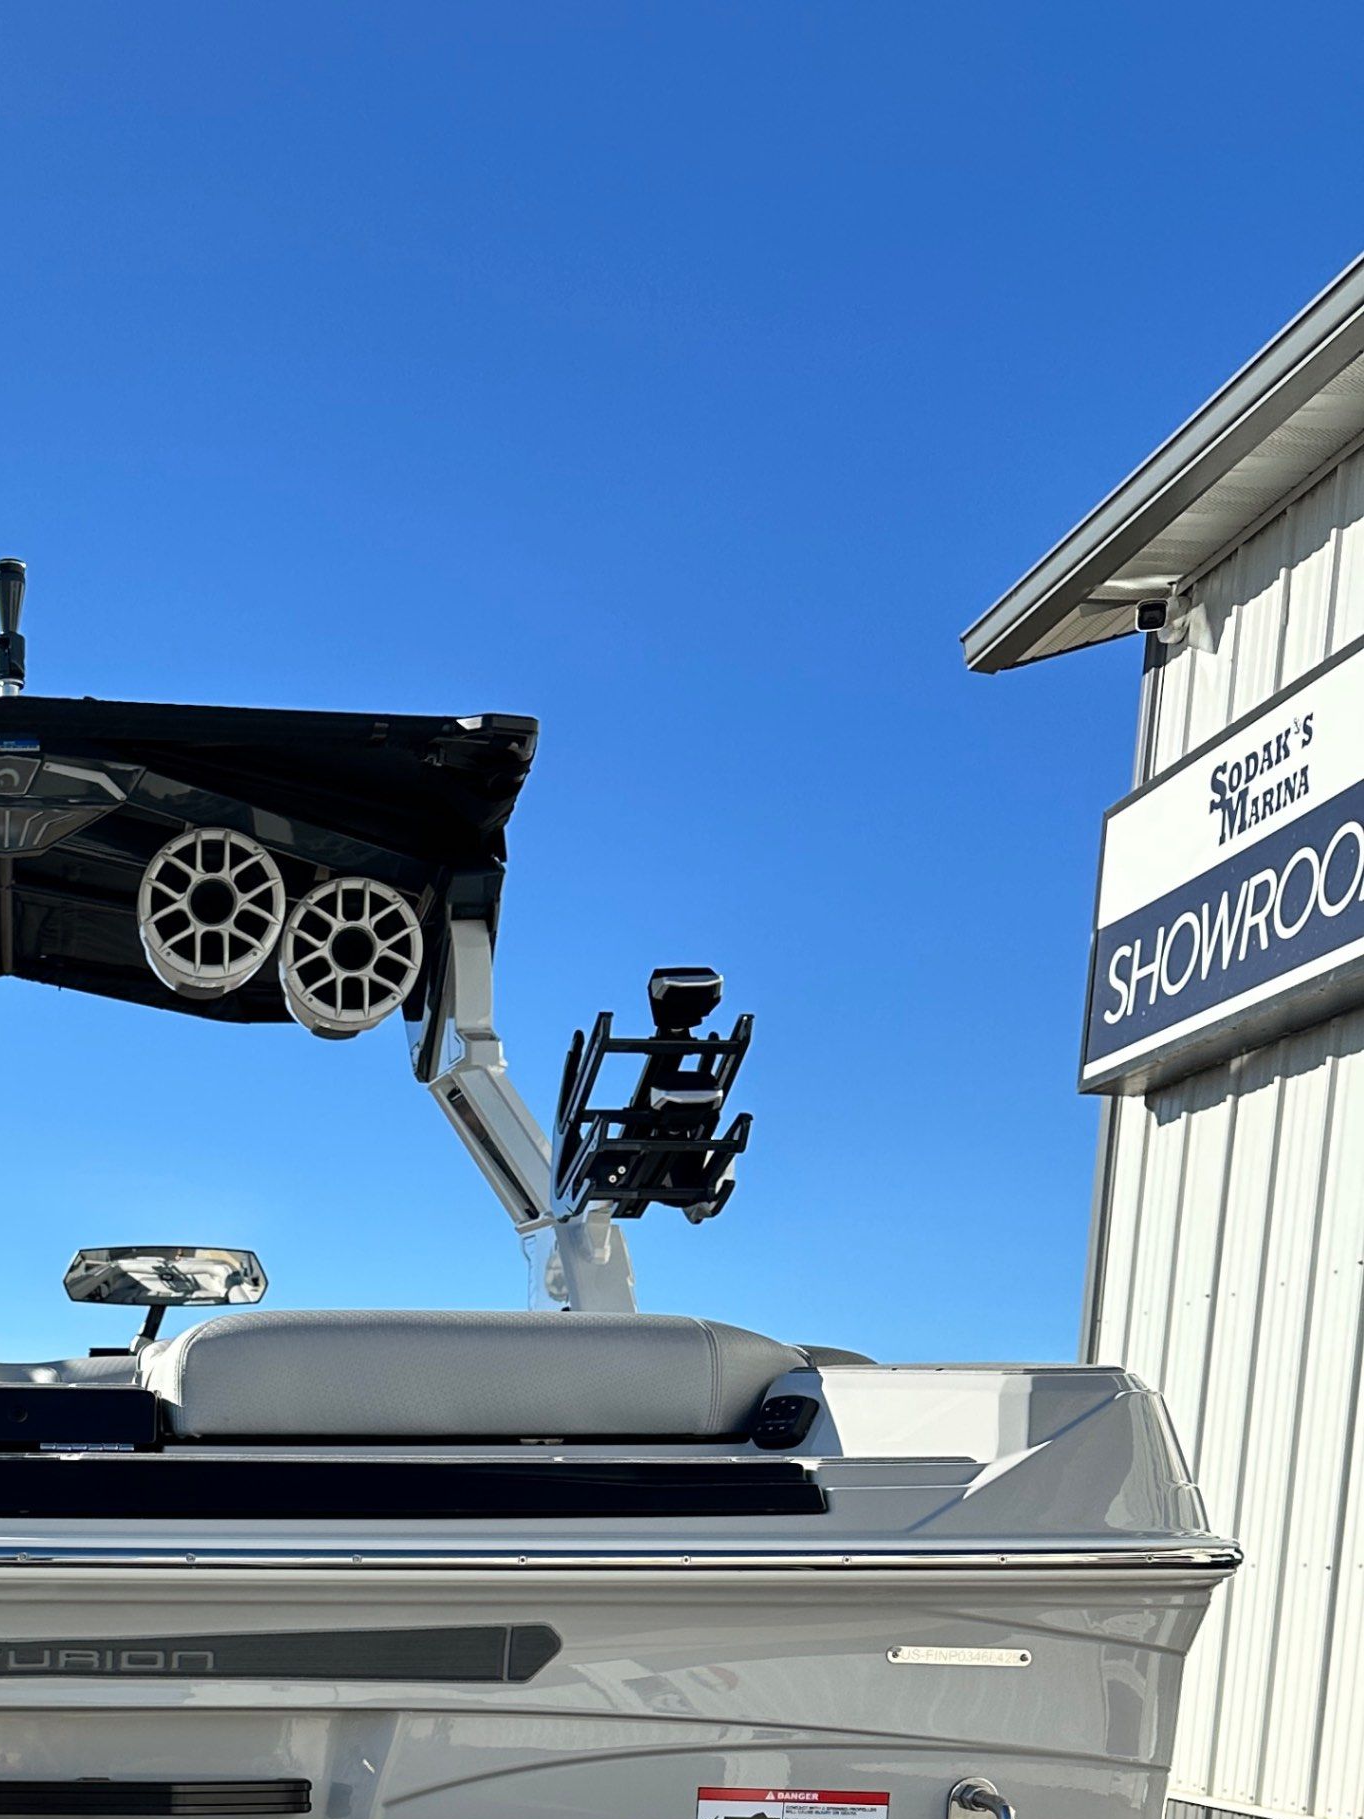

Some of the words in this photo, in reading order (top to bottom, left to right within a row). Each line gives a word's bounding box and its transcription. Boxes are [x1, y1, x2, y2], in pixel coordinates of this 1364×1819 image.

[1218, 764, 1310, 847] MARINA
[1103, 819, 1364, 1026] SHOWROO
[777, 1792, 819, 1801] DANGER
